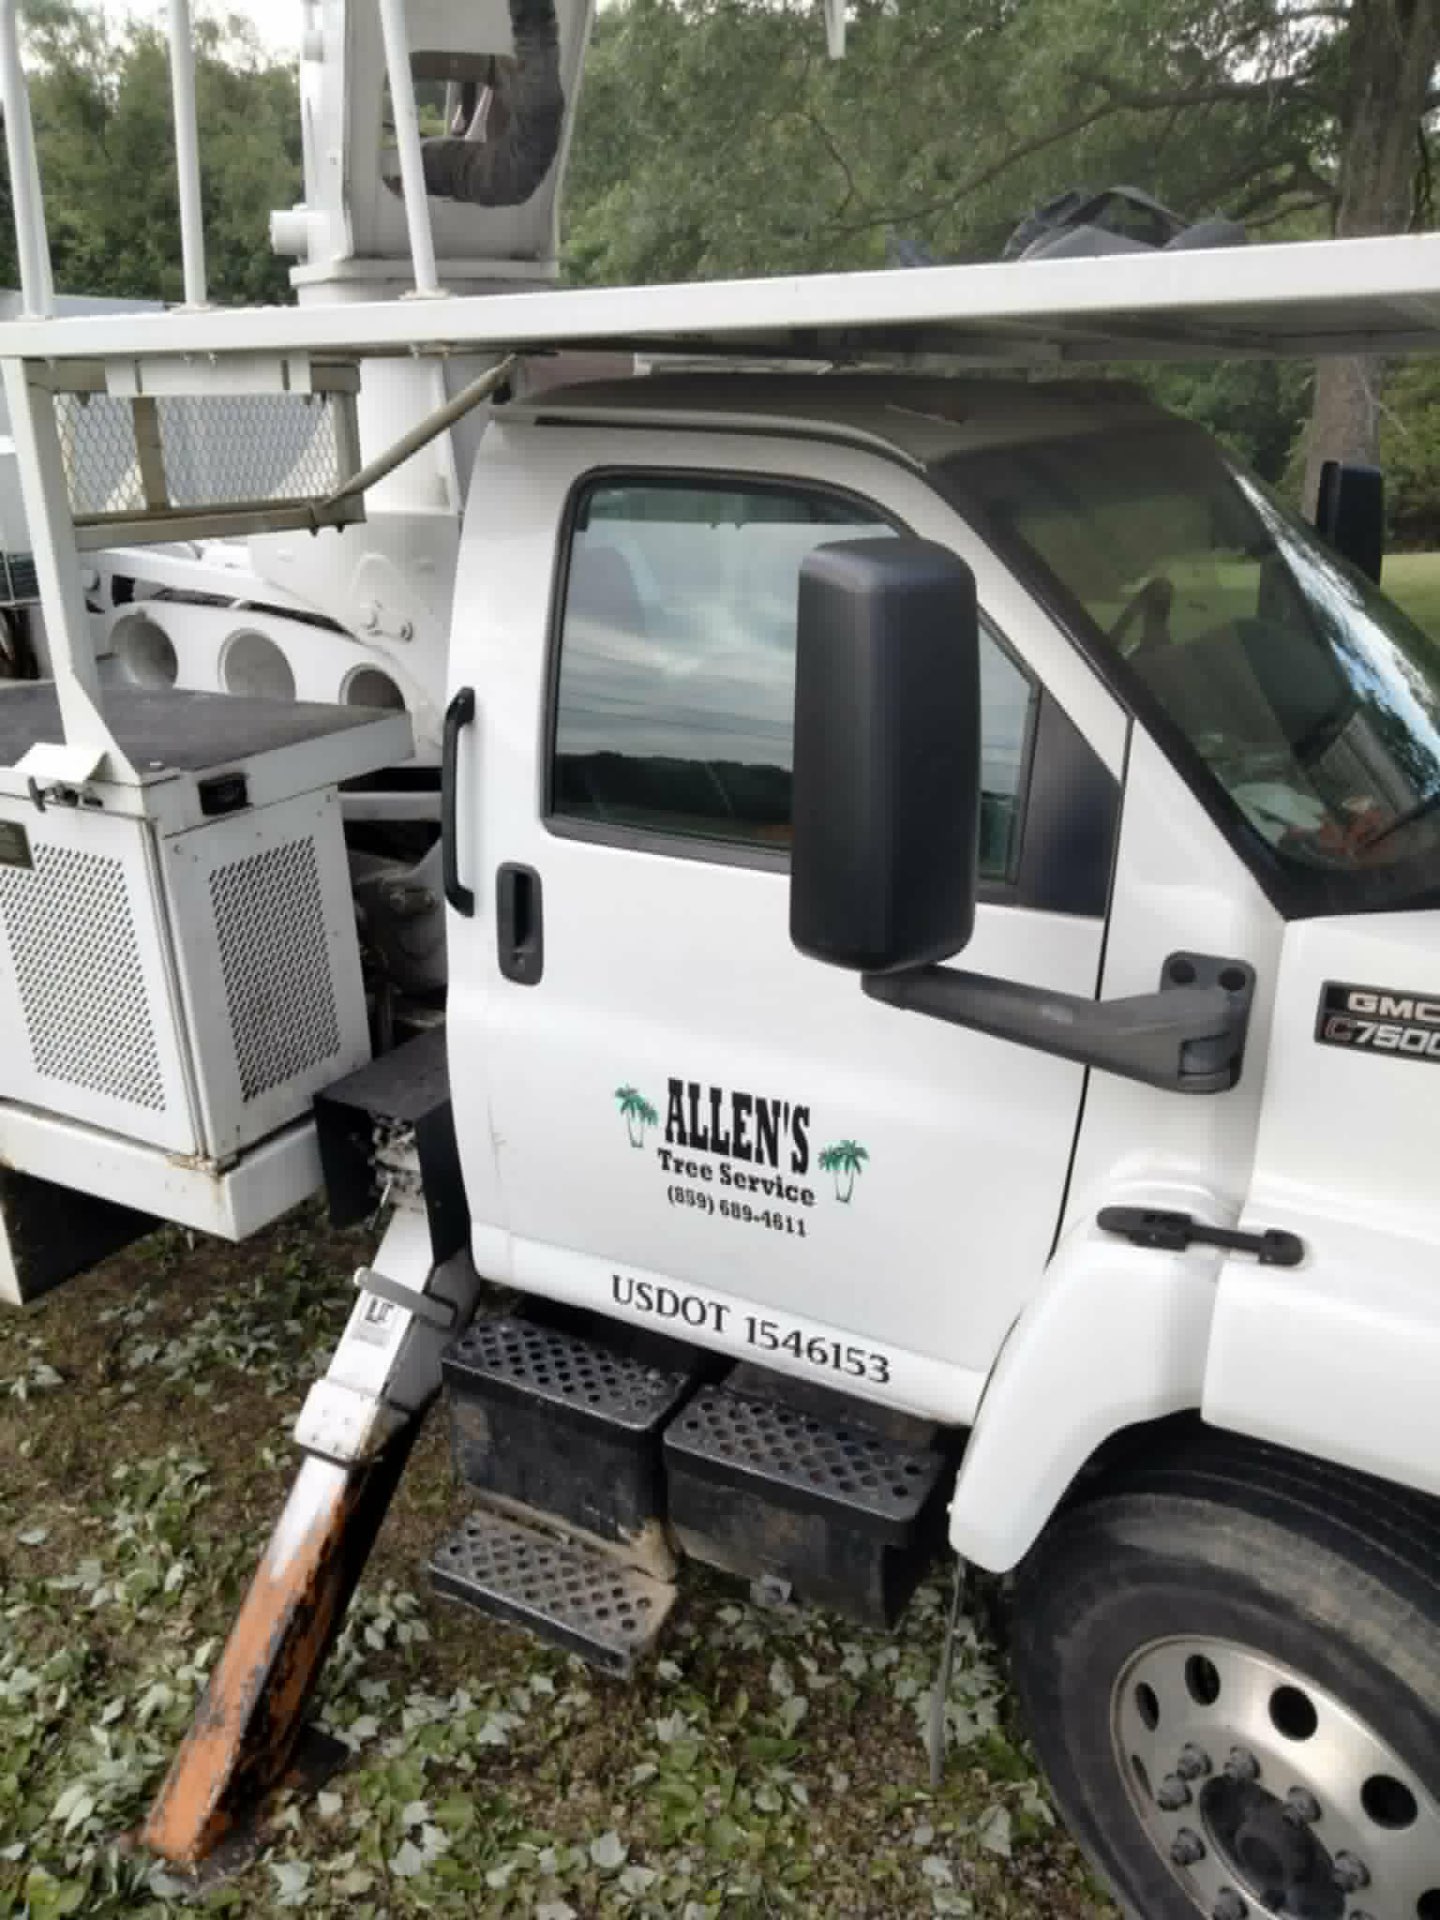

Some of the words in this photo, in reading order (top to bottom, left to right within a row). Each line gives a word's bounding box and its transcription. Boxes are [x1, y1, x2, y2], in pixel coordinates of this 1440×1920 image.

[1348, 991, 1440, 1021] GMC
[665, 1077, 810, 1176] ALLEN'S
[657, 1147, 713, 1182] Tree
[719, 1162, 816, 1207] Service
[719, 1199, 807, 1238] 689-4611
[612, 1274, 731, 1333] USDOT
[744, 1315, 891, 1383] 1546153
